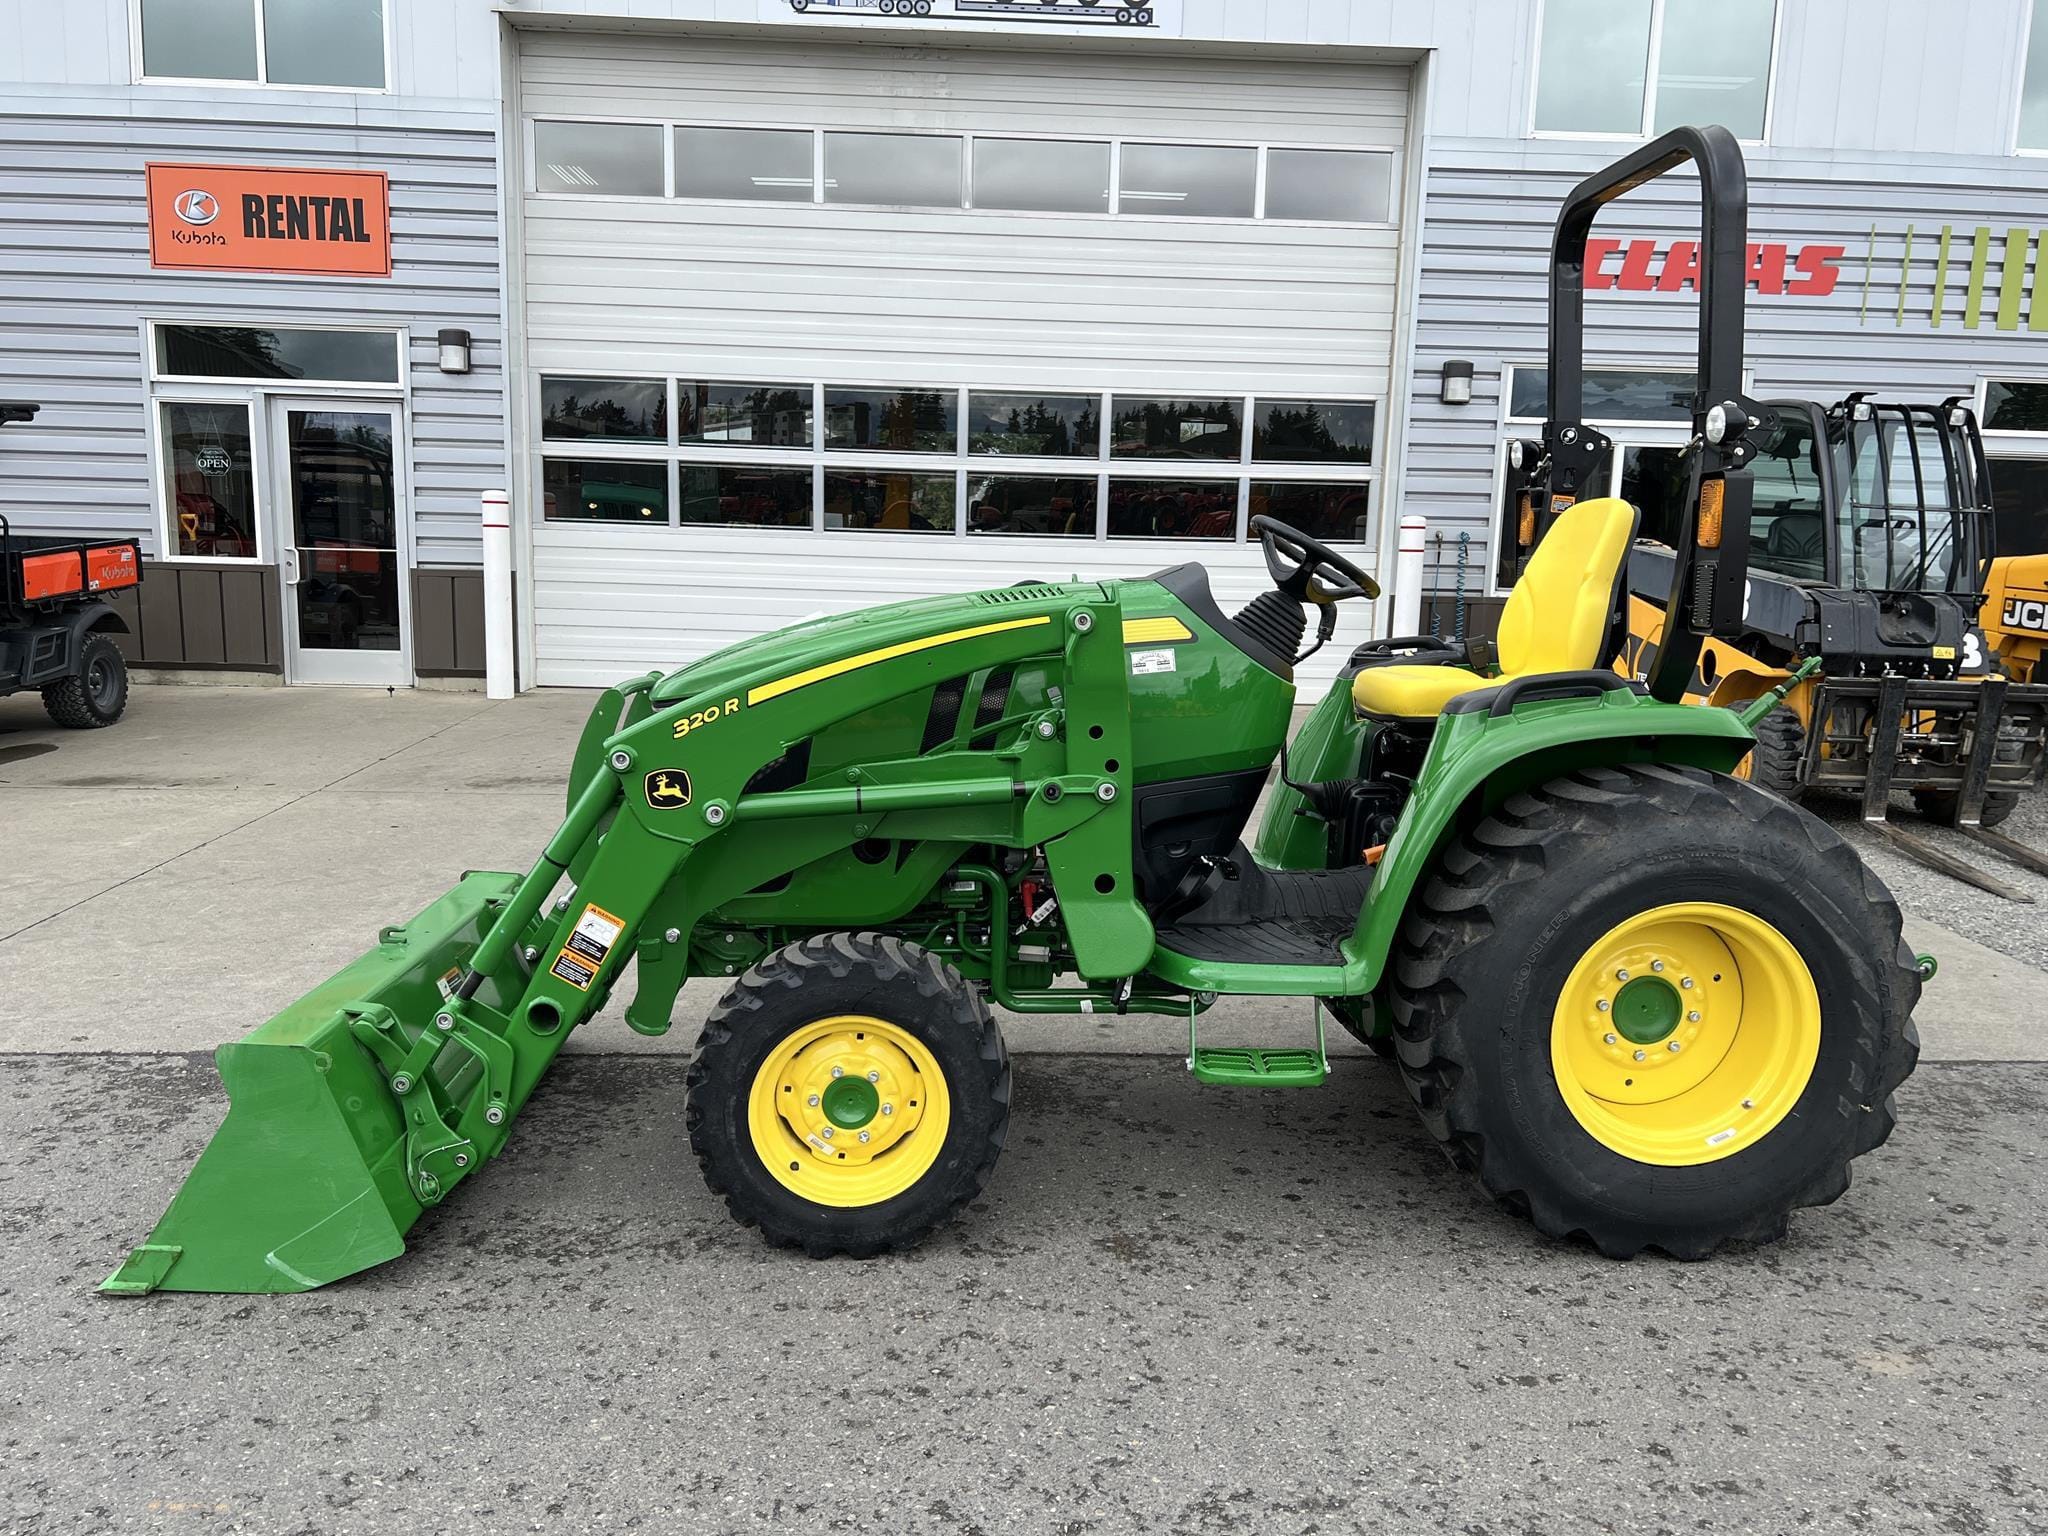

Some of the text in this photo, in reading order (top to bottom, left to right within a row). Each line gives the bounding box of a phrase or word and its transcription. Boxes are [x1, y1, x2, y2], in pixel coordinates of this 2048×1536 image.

[241, 193, 371, 243] RENTAL
[172, 230, 226, 246] Kubota
[1583, 239, 1846, 297] CLAAS
[198, 458, 229, 468] OPEN
[102, 563, 135, 579] Kubota
[2003, 600, 2048, 631] JC
[673, 697, 741, 739] 320 R
[597, 909, 621, 926] WARNING
